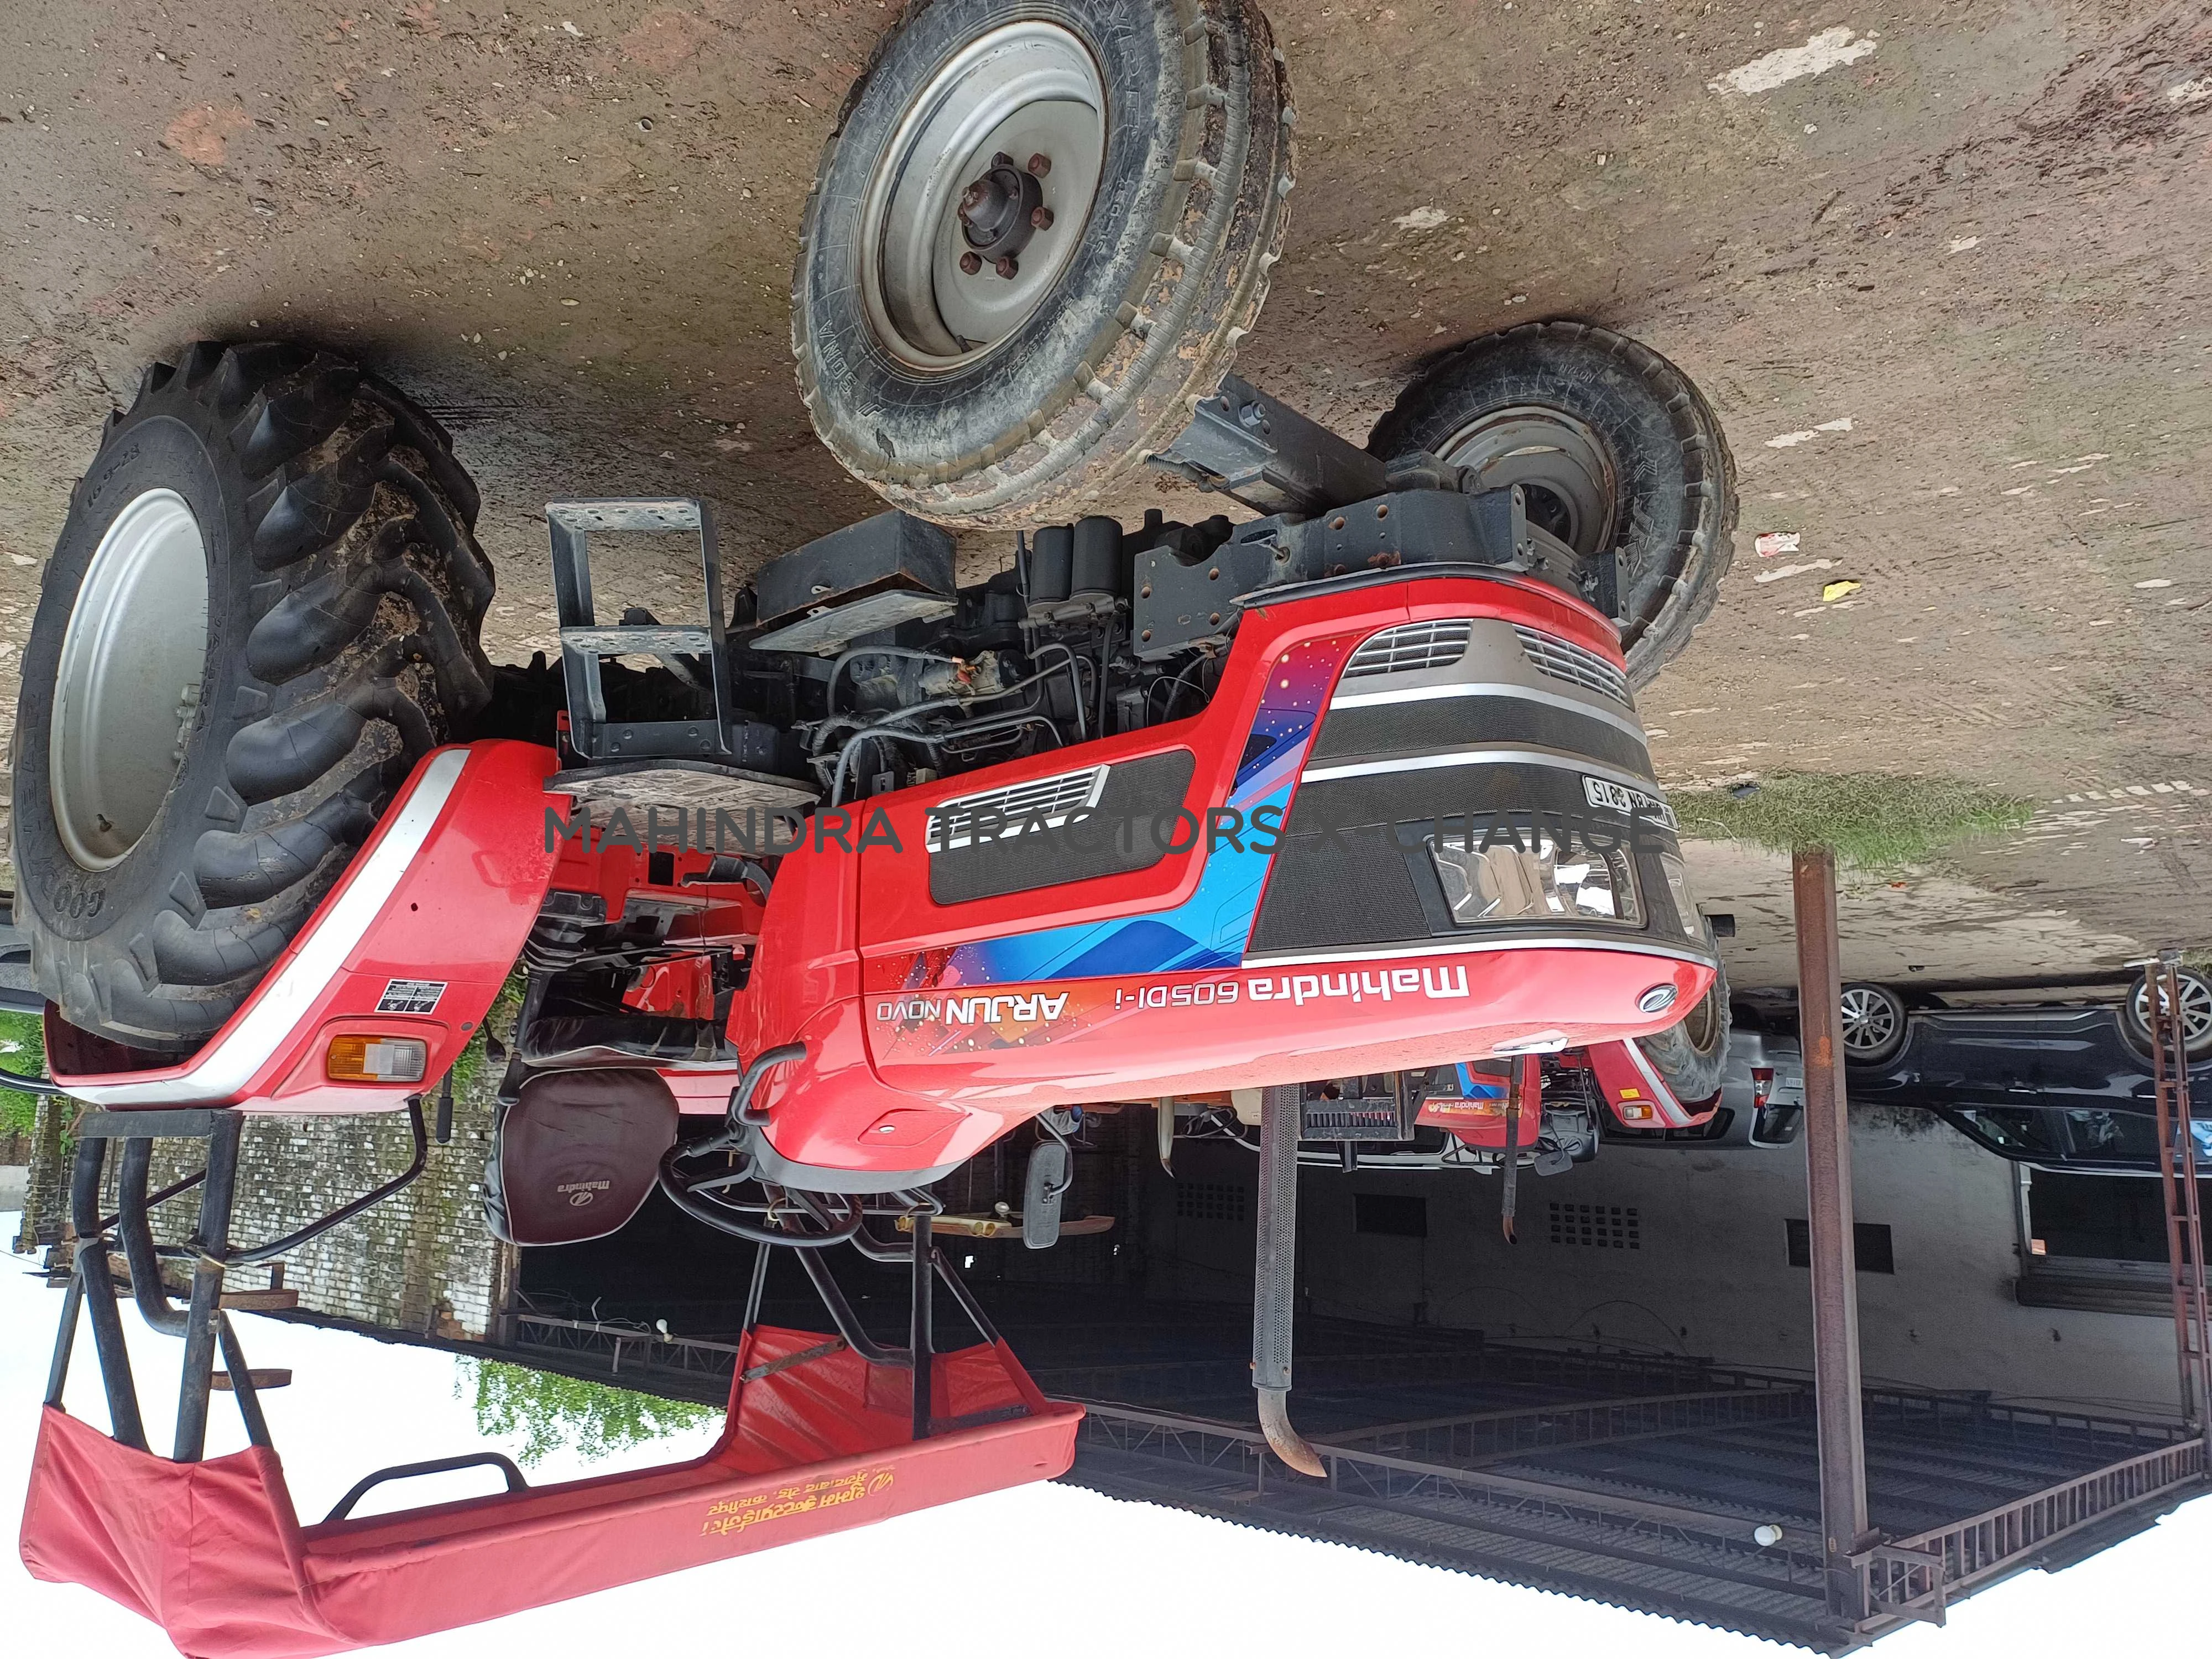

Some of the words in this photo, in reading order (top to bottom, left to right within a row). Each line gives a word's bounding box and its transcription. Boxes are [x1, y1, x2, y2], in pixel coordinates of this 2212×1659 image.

[818, 319, 858, 394] SONA
[1558, 362, 1595, 384] NYLON
[1247, 965, 1470, 1006] Mahindra
[877, 999, 941, 1021] NOVO
[945, 992, 1070, 1025] ARJUN
[557, 1180, 610, 1193] Mahindra
[802, 1469, 868, 1494] मुरादाबाद
[817, 1481, 865, 1508] शुभम
